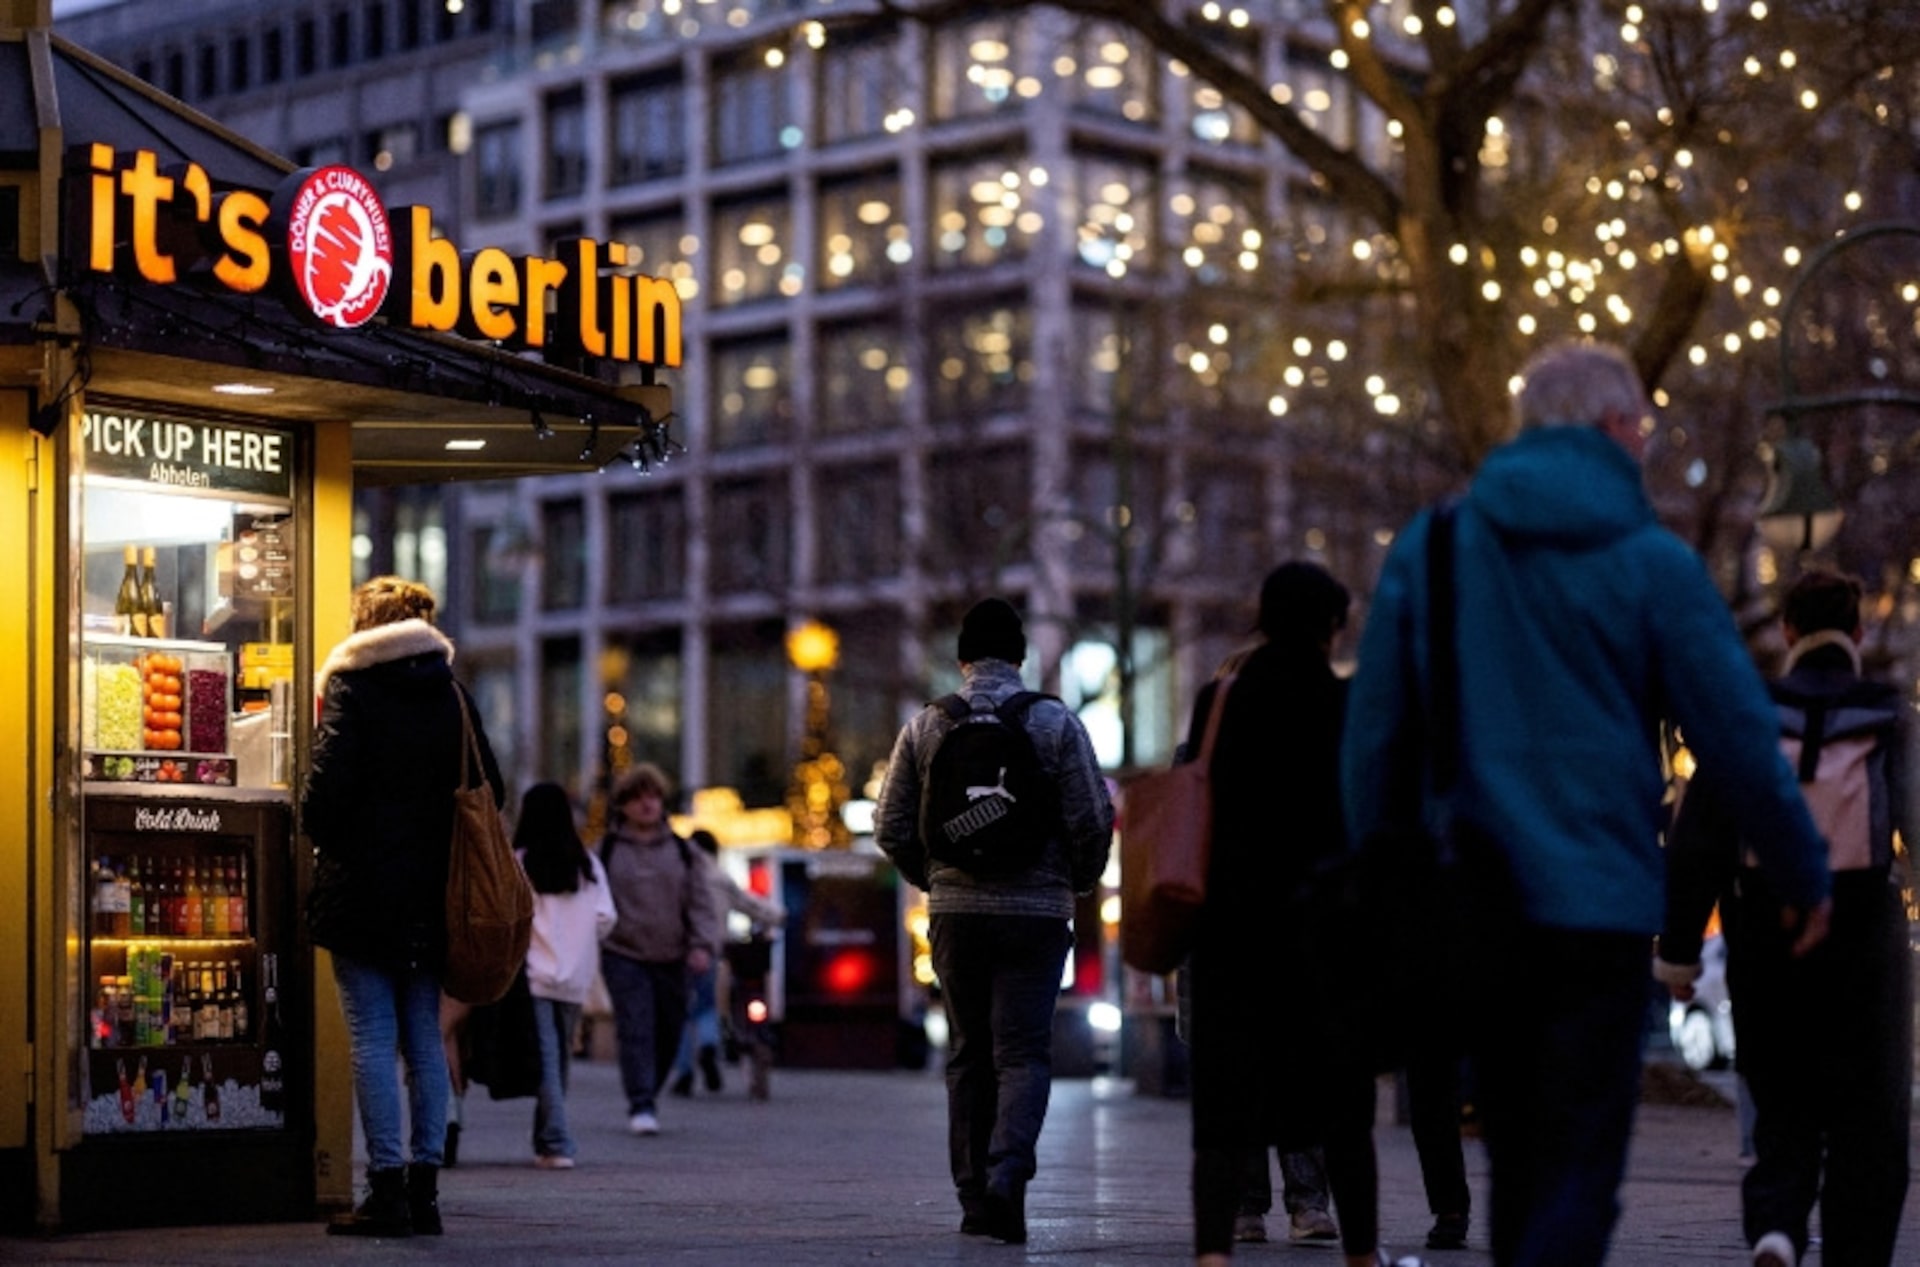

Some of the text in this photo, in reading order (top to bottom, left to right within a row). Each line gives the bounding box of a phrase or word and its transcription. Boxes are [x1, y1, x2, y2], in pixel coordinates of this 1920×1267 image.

[290, 171, 390, 252] DÖNER & CURRYWURST
[91, 143, 682, 368] it's berlin
[153, 421, 194, 462] UP
[202, 427, 282, 473] HERE
[150, 462, 210, 487] Abholen
[135, 808, 220, 831] Cold Drink
